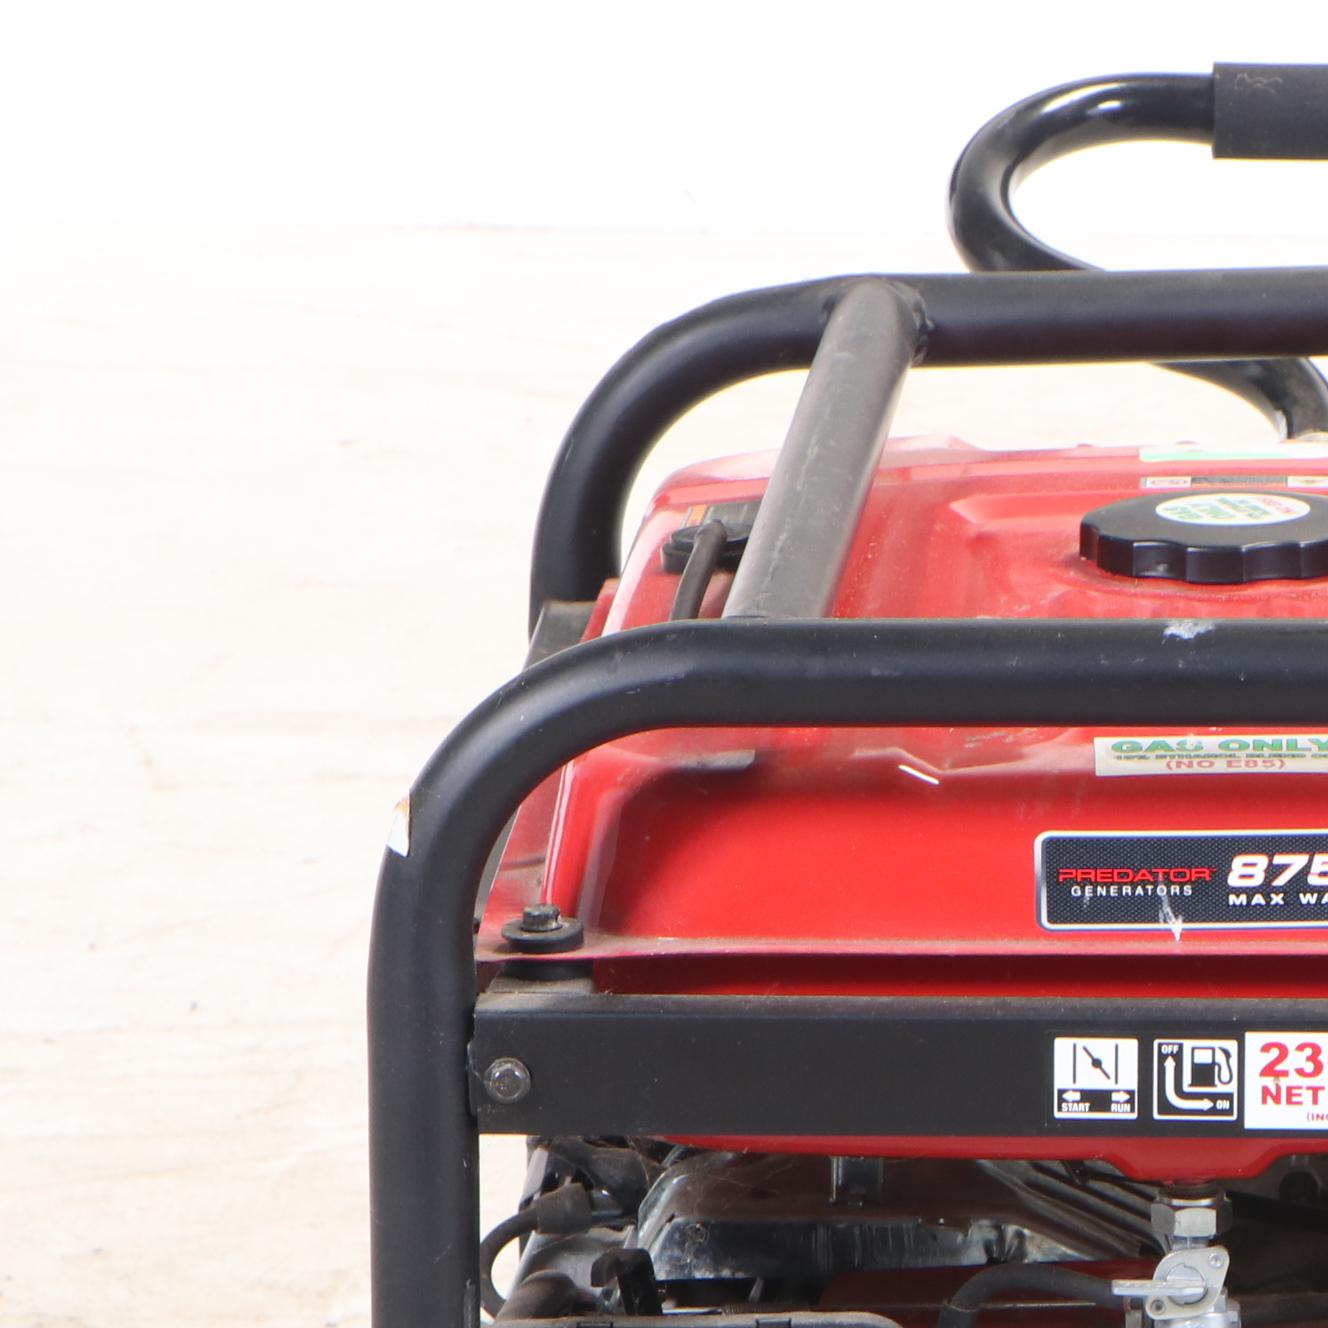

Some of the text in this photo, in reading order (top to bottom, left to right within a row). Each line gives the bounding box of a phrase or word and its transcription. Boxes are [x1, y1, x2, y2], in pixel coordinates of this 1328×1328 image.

[1111, 739, 1204, 753] GAS
[1166, 759, 1286, 771] (NO E85)
[1058, 868, 1212, 882] PREDATOR
[1071, 885, 1193, 897] GENERATORS
[1228, 893, 1285, 906] MAX
[1161, 1044, 1180, 1055] OFF
[1261, 1085, 1326, 1107] NET
[1061, 1103, 1131, 1113] START RUN
[1216, 1100, 1230, 1110] ON
